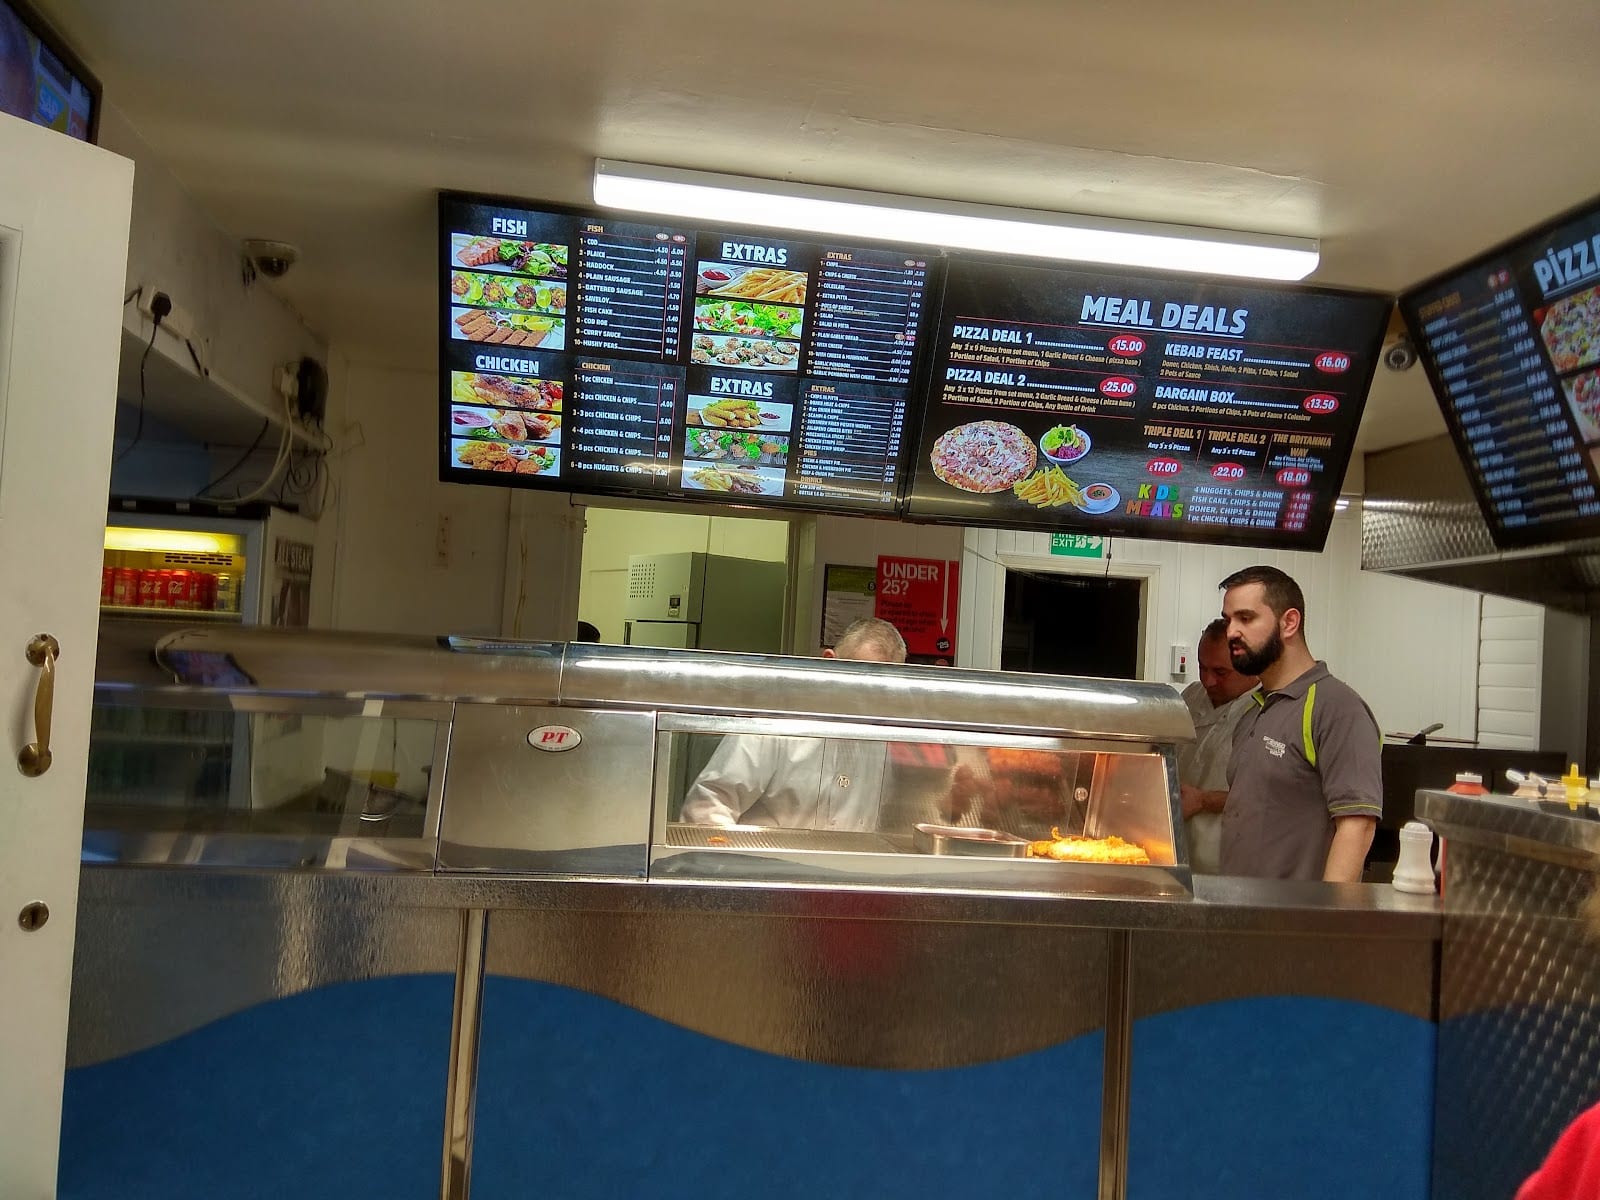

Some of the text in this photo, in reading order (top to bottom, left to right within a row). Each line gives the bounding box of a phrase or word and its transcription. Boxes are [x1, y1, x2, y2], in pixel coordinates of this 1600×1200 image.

[492, 218, 527, 235] FISH
[722, 242, 787, 264] EXTRAS
[827, 252, 852, 260] EXTRAS
[586, 262, 614, 270] HADDOCK
[604, 275, 630, 283] SAUSAGE
[585, 284, 643, 296] BATTERED SAUSAGE
[585, 295, 609, 303] SAVELOY
[1080, 295, 1248, 334] MEAL DEALS
[953, 326, 1142, 351] PIZZA DEAL 1 £15.00
[980, 344, 997, 353] Pizzas
[954, 352, 975, 360] Portion
[1034, 359, 1050, 368] Chips
[1165, 343, 1348, 369] KEBAB FEAST £16.00
[475, 355, 539, 373] CHICKEN
[582, 362, 610, 371] CHICKEN
[592, 376, 614, 384] CHICKEN
[946, 368, 1134, 393] PIZZA DEAL 2 £25.00
[710, 376, 773, 397] EXTRAS
[999, 398, 1020, 406] Portion
[1155, 386, 1334, 410] BARGAIN BOX £13.50
[595, 411, 618, 420] CHICKEN
[625, 414, 641, 422] CHIPS
[595, 428, 618, 437] CHICKEN
[1144, 425, 1201, 439] TRIPLE DEAL 1
[1208, 430, 1266, 444] TRIPLE DEAL 2
[1273, 433, 1289, 443] THE
[594, 445, 618, 454] CHICKEN
[1290, 448, 1309, 457] WAY
[594, 463, 619, 472] NUGGETS
[1149, 462, 1177, 472] £17.00
[1214, 466, 1244, 478] £22.00
[1279, 471, 1308, 482] £18.00
[1138, 484, 1180, 501] KIDS
[1126, 500, 1184, 518] MEALS
[1052, 538, 1074, 547] EXIT
[883, 562, 938, 580] UNDER
[882, 579, 910, 595] 25?
[541, 732, 569, 743] PT
